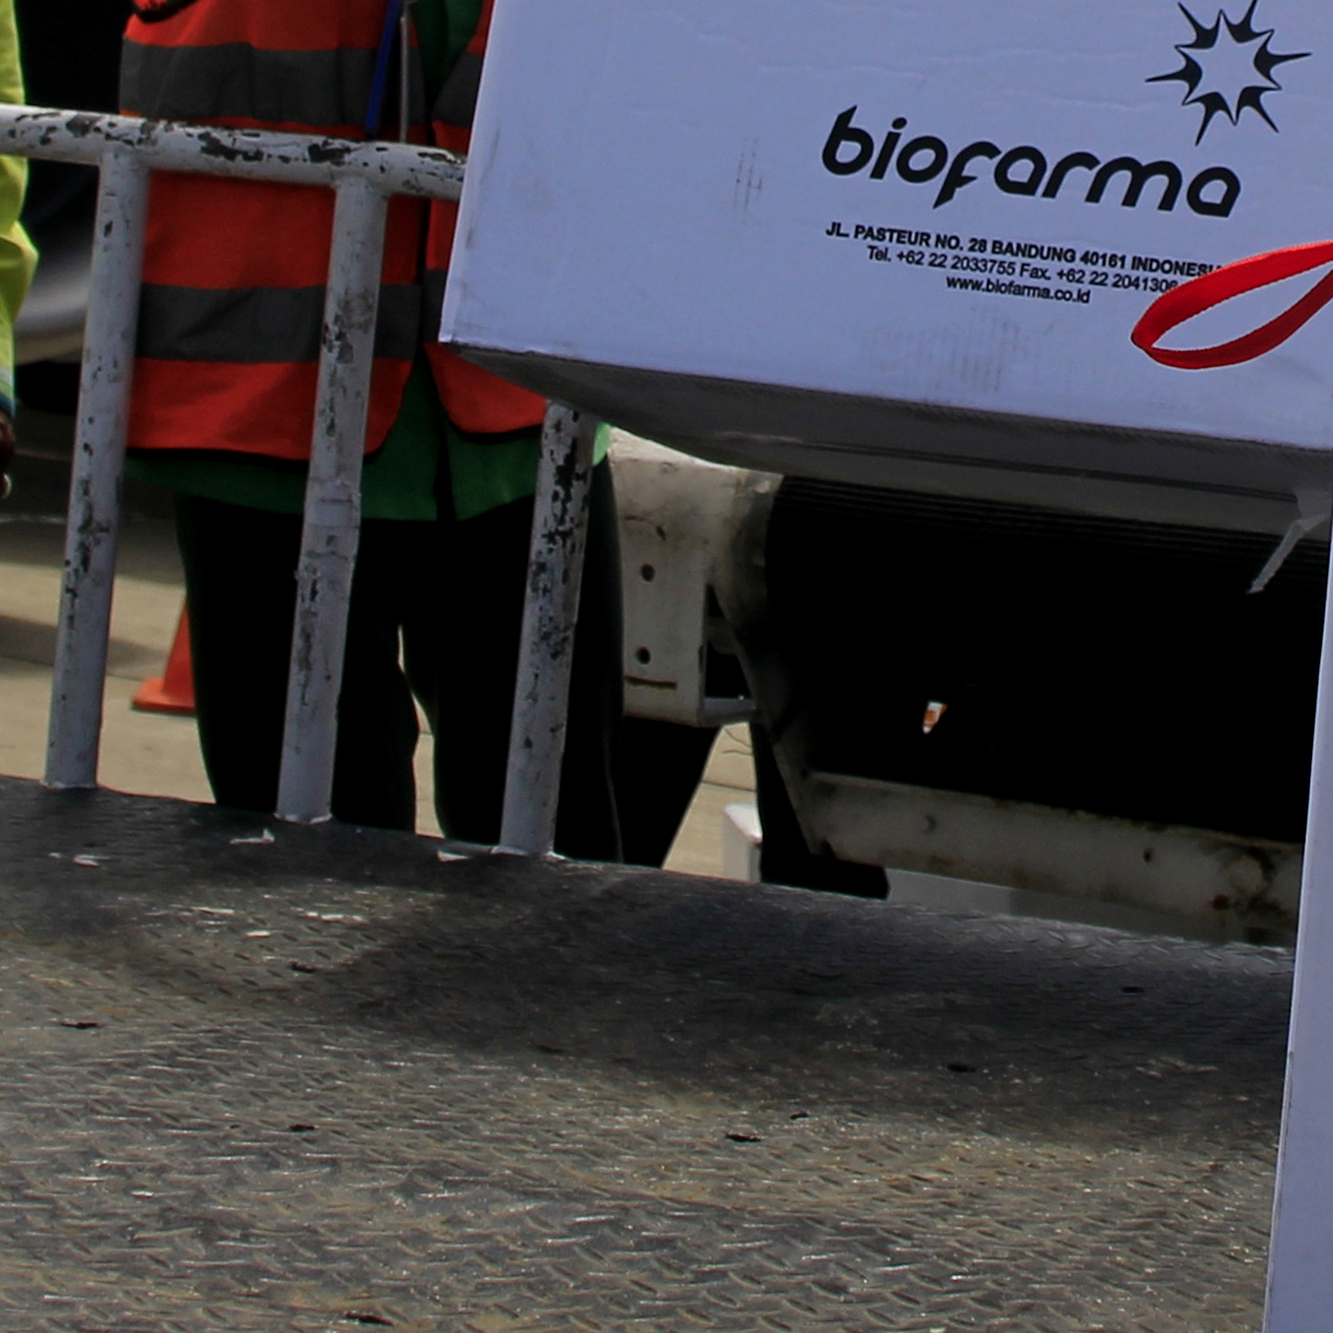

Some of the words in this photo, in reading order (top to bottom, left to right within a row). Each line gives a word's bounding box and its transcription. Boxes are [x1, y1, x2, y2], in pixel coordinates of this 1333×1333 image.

[820, 105, 1242, 218] biofarma
[854, 224, 931, 248] PASTEUR
[935, 234, 964, 251] NO.
[968, 237, 987, 253] 28
[991, 240, 1076, 263] BANDUNG
[1080, 250, 1126, 268] 40161
[867, 245, 892, 262] Tel.
[897, 250, 924, 266] +62
[928, 253, 947, 268] 22
[951, 256, 1015, 276] 2033755
[1020, 262, 1052, 280] Fax.
[1056, 268, 1085, 284] +62
[1088, 271, 1108, 286] 22
[946, 276, 1090, 304] www.biofarma.co.id
